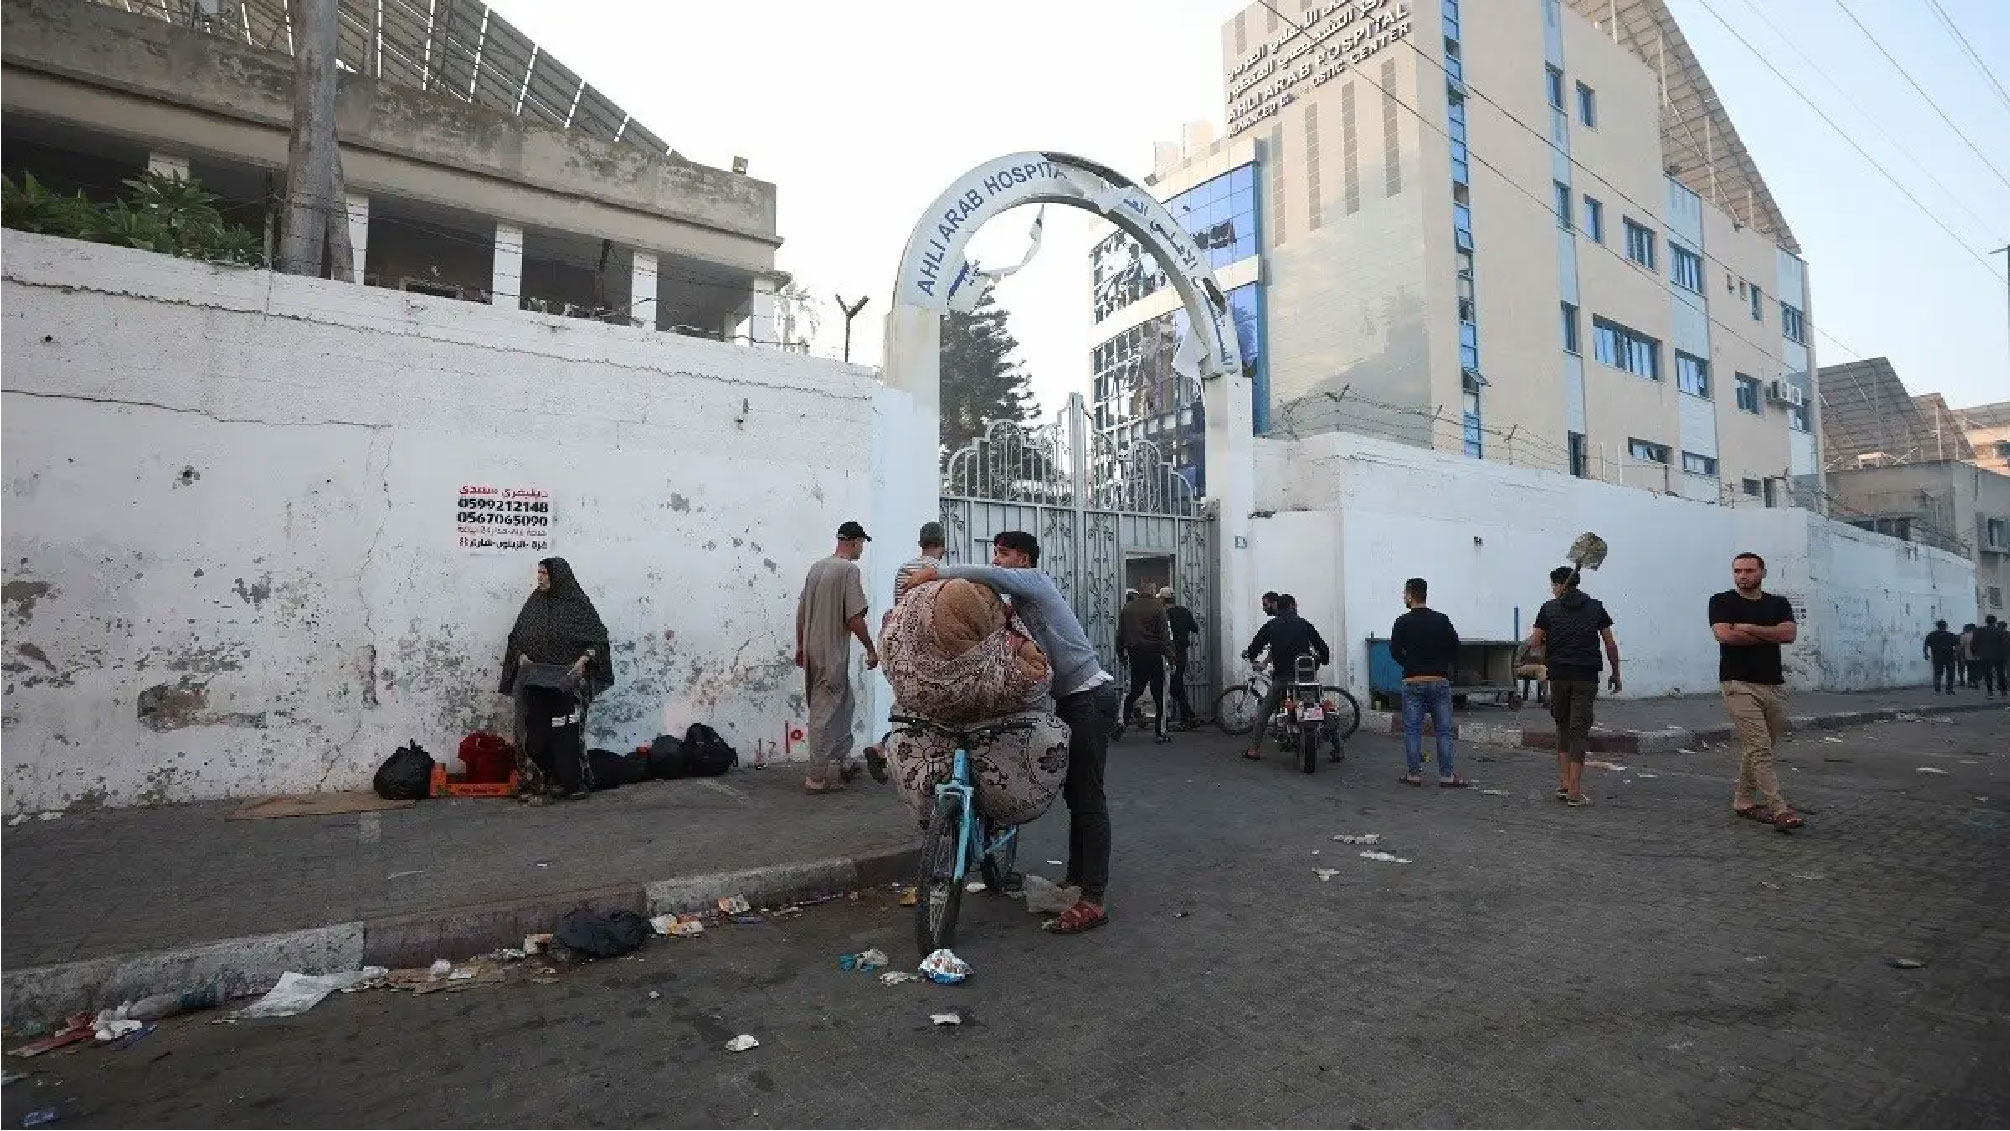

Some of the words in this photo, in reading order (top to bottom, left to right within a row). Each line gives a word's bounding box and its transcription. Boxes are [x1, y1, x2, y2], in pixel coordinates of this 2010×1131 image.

[1228, 91, 1263, 123] AHLI
[1265, 63, 1312, 101] ARAB
[1315, 3, 1409, 65] HOSPITAL
[1350, 22, 1411, 64] CENTER
[917, 239, 946, 298] AHLI
[944, 189, 985, 243] ARAB
[984, 161, 1069, 197] HOSPITA
[458, 499, 549, 512] 0599212148
[458, 511, 548, 526] 0567065090
